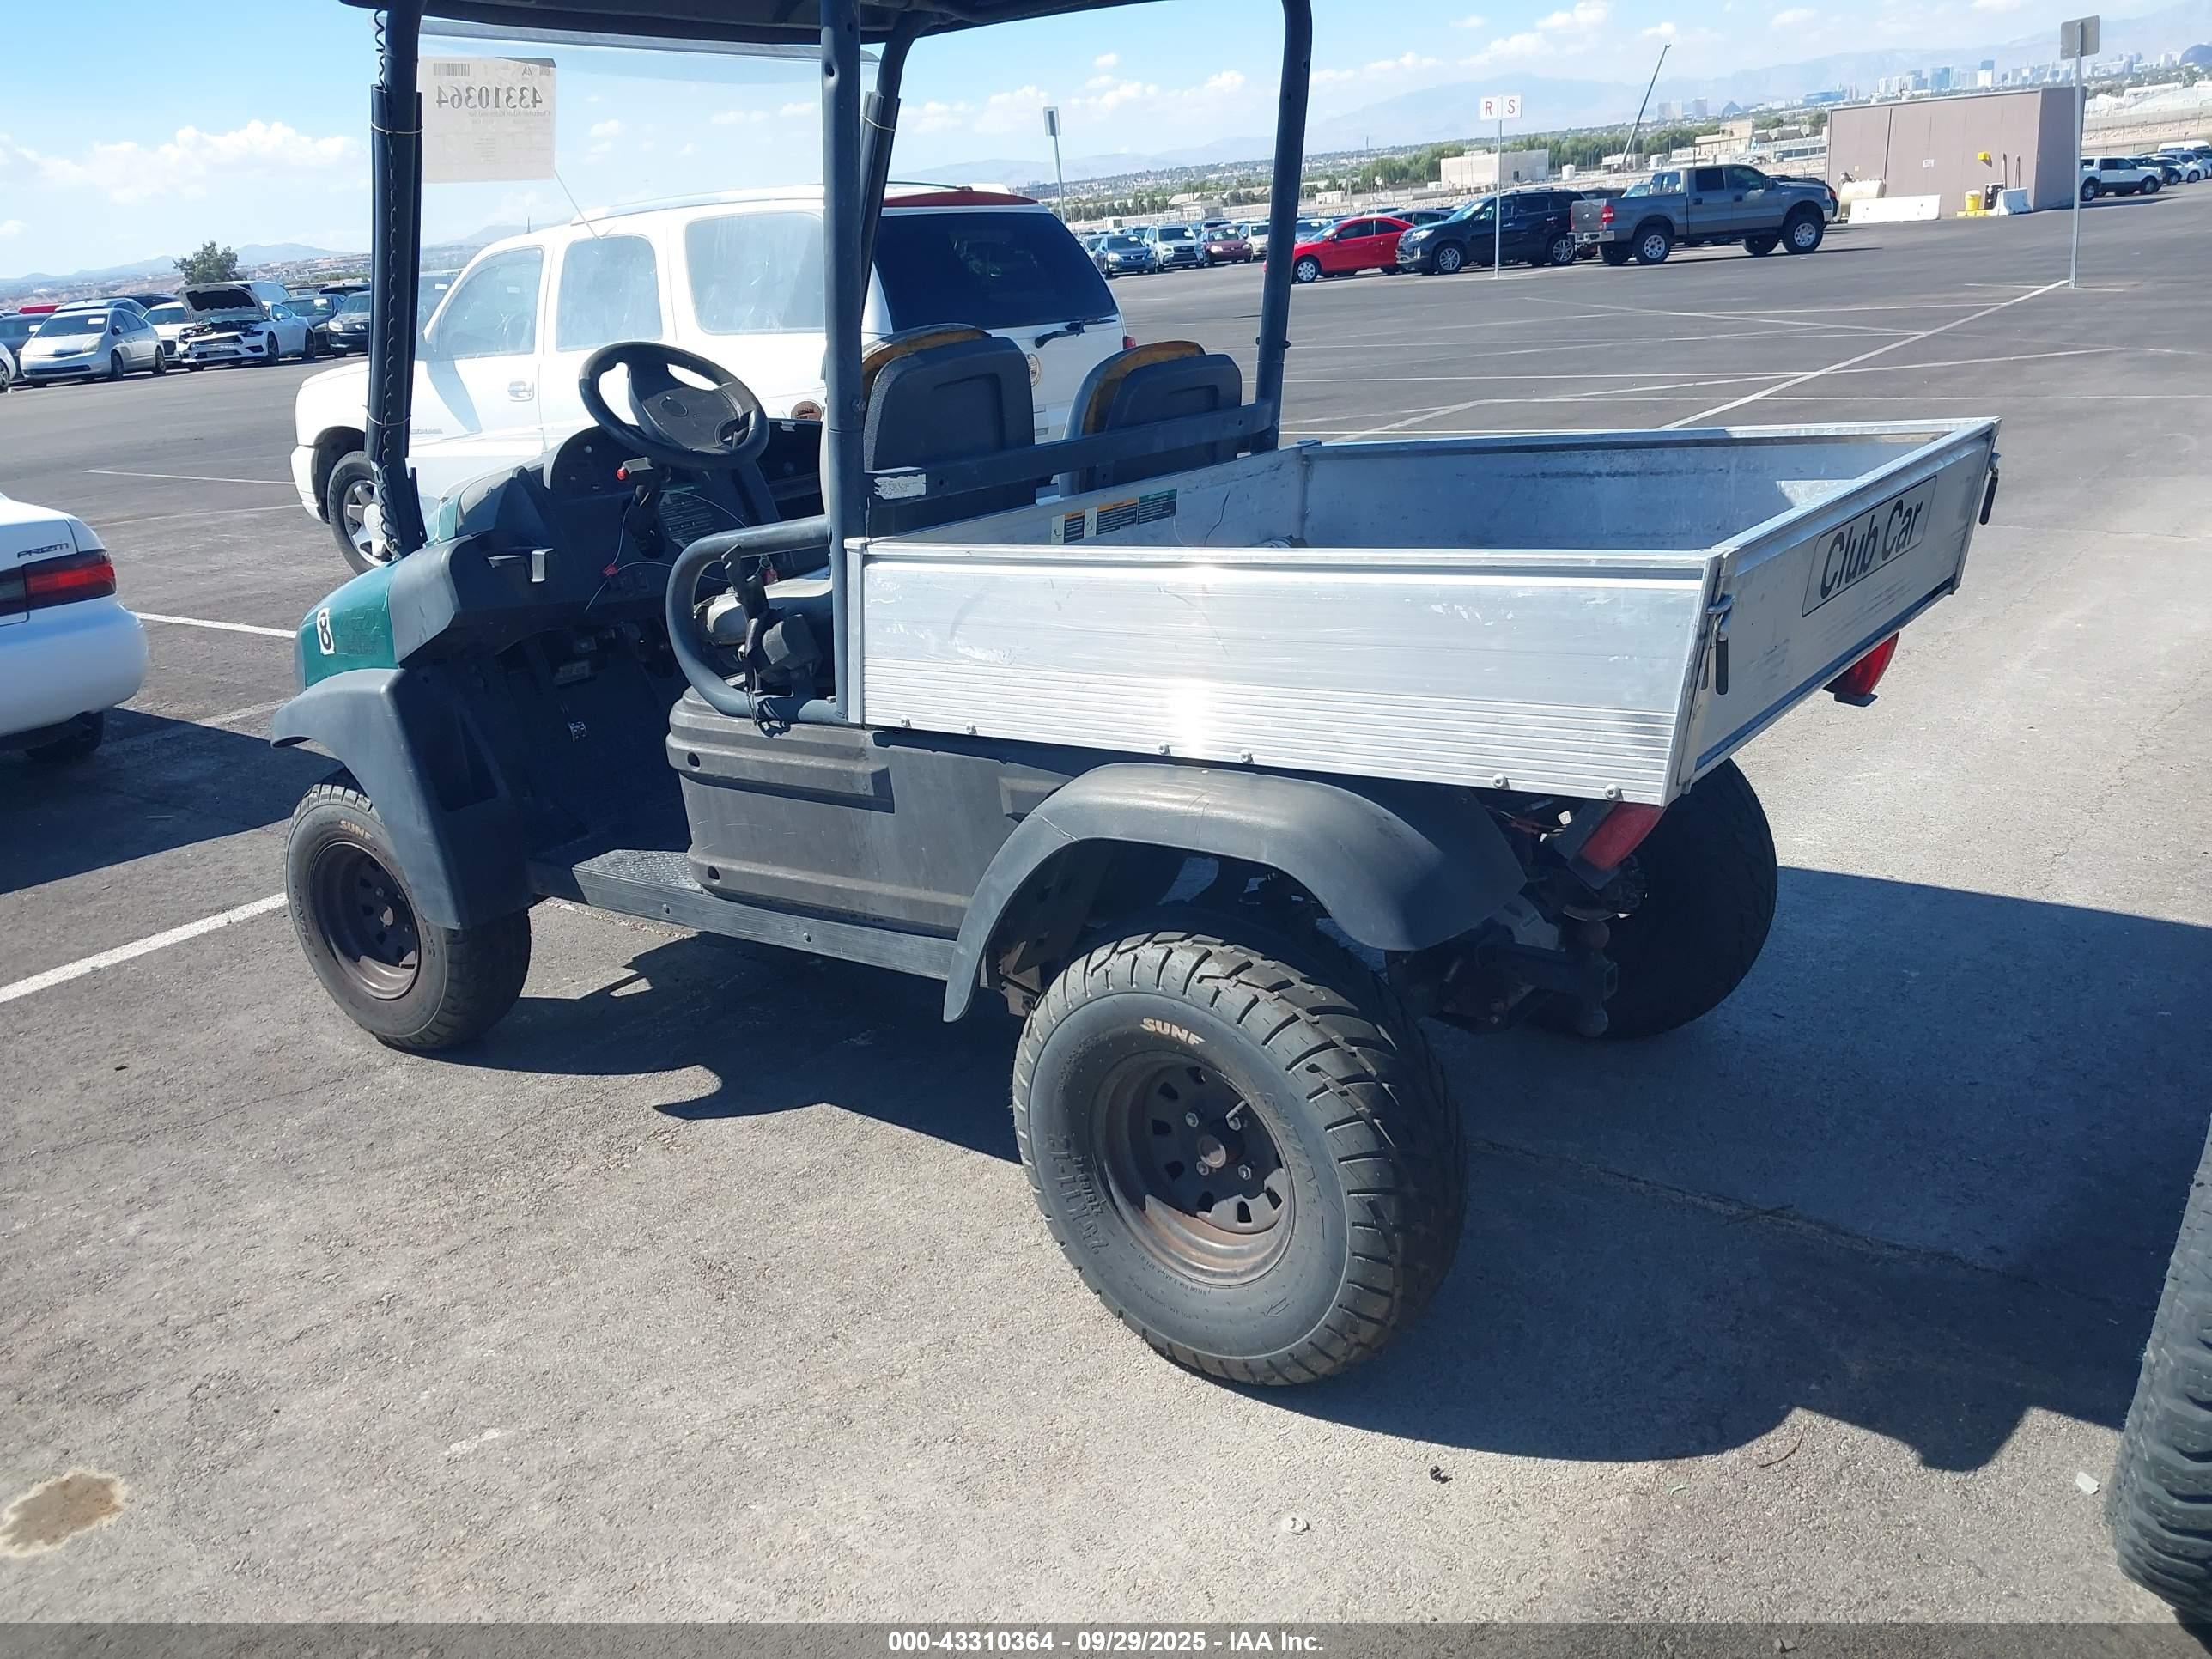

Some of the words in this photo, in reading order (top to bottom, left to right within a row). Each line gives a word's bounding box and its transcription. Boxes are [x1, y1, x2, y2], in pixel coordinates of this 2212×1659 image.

[1485, 100, 1492, 116] R
[1507, 99, 1516, 114] S
[1820, 514, 1879, 599] Club
[1881, 499, 1924, 561] Car
[1139, 1017, 1206, 1045] SUNF
